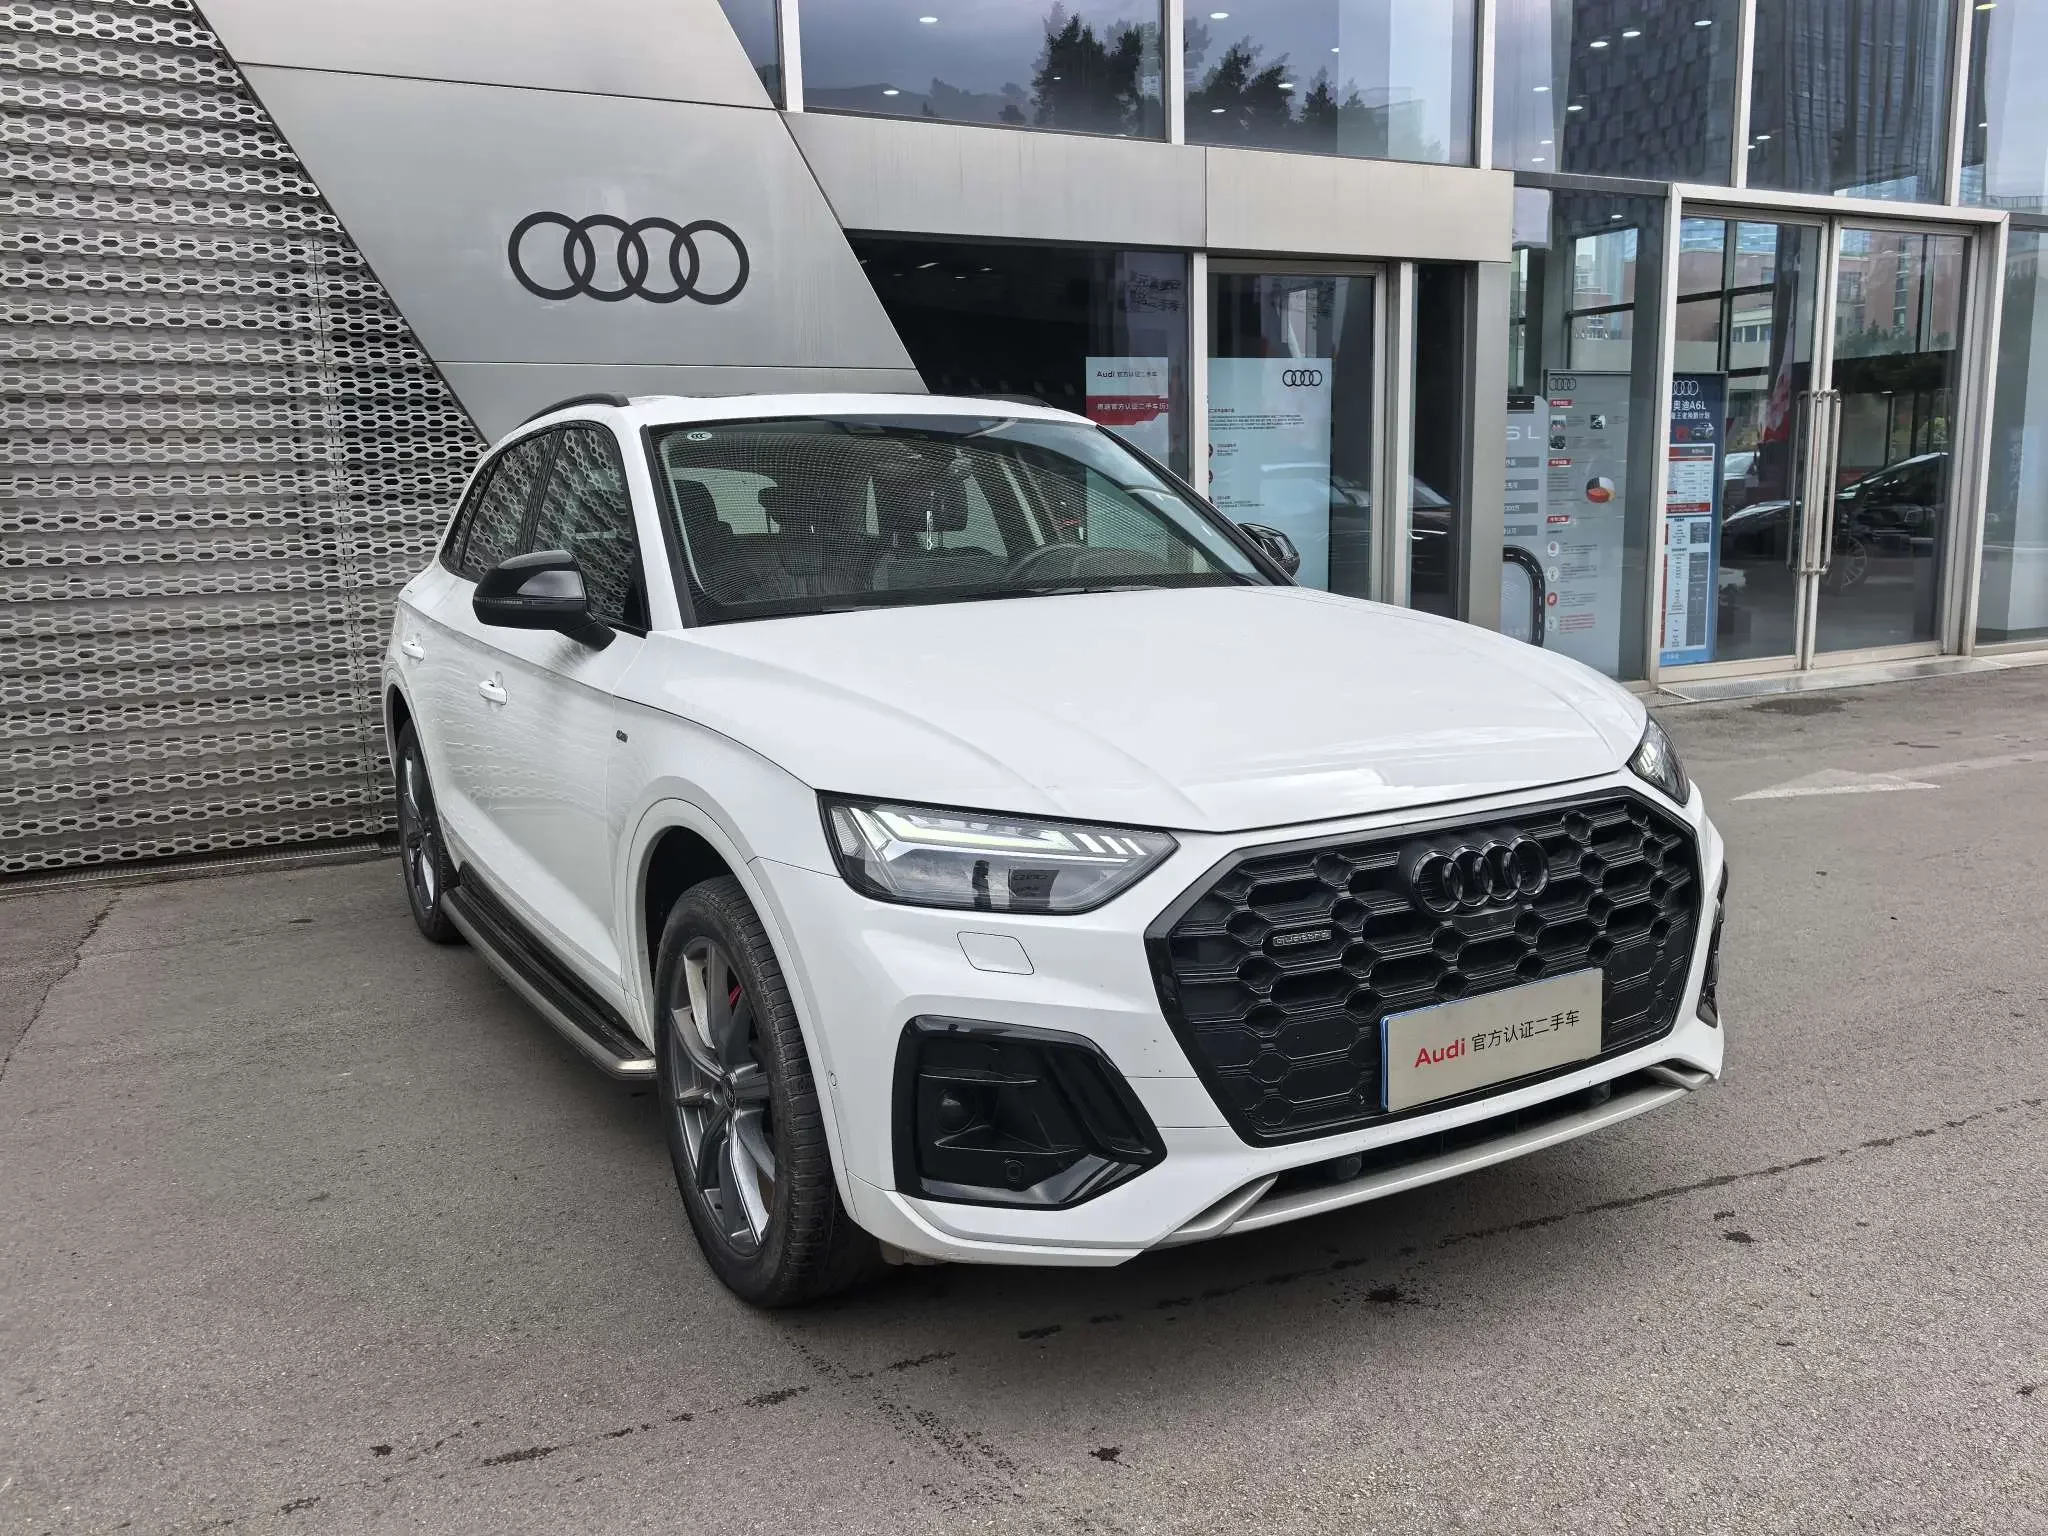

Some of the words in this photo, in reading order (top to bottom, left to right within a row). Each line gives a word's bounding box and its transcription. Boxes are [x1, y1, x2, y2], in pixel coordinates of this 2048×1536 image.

[1097, 370, 1115, 378] Audi
[1673, 400, 1706, 411] 奥迪A6L
[1414, 1038, 1466, 1068] Audi
[1471, 1009, 1580, 1052] 官方认证二手车
